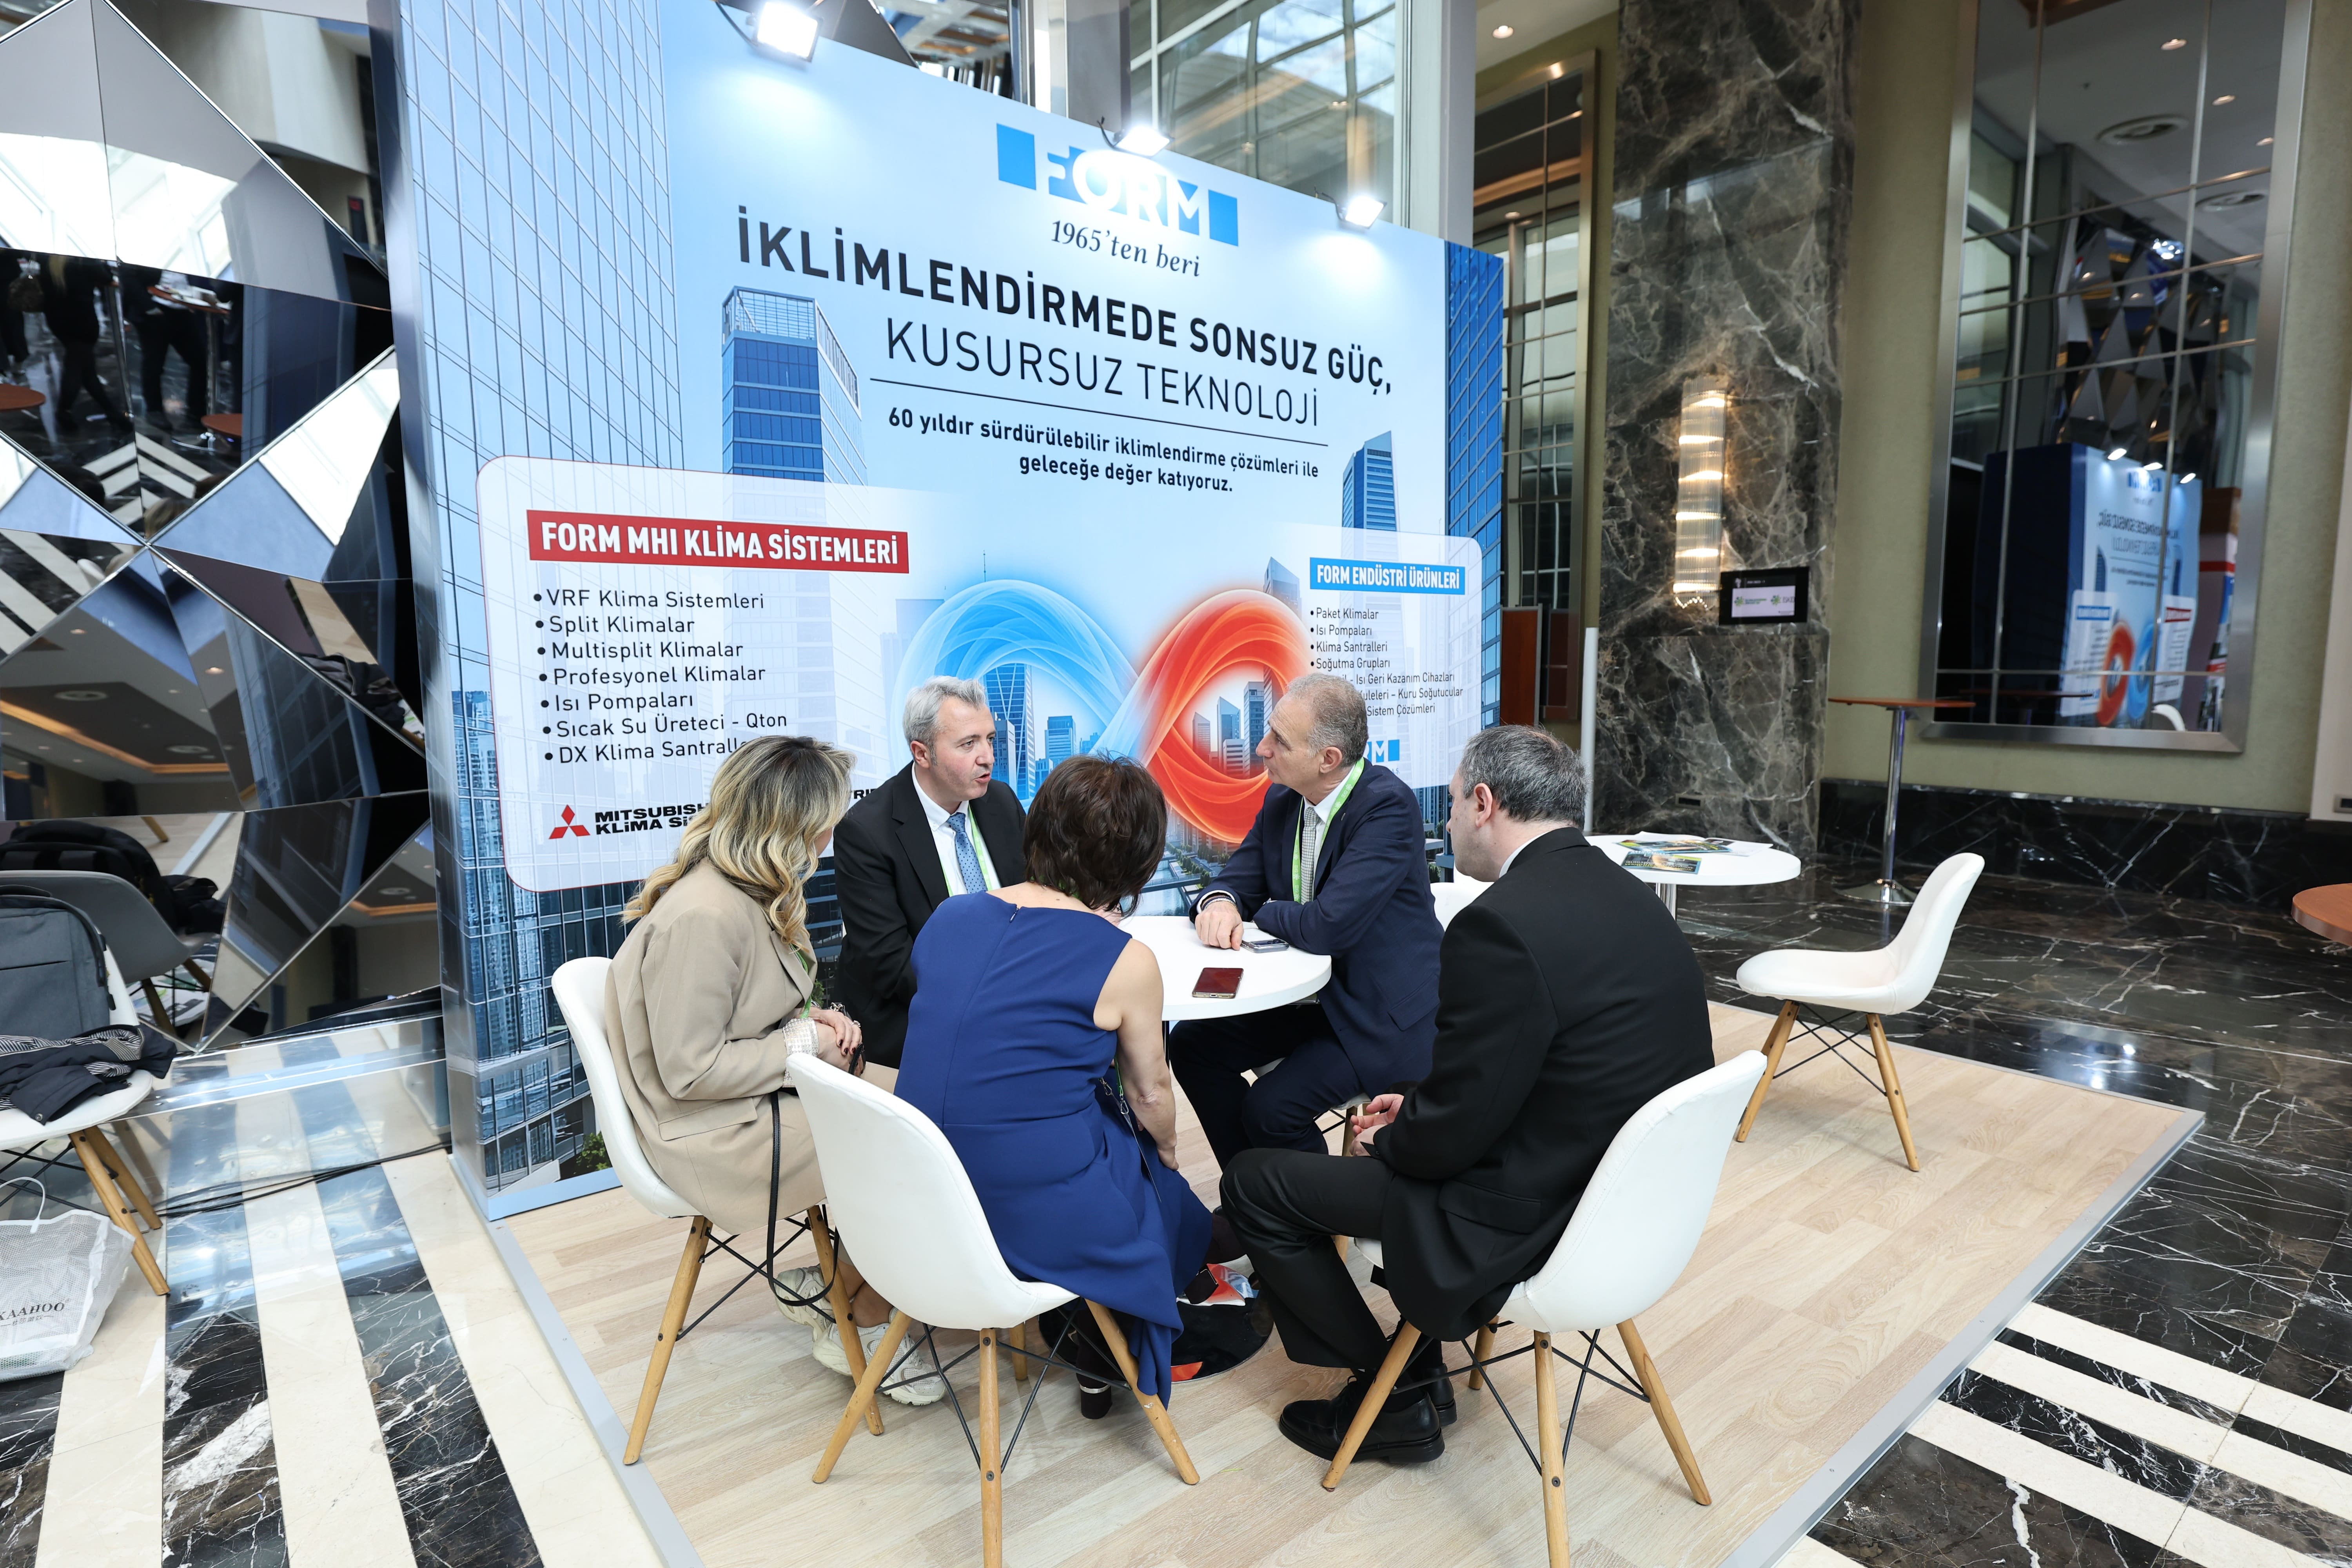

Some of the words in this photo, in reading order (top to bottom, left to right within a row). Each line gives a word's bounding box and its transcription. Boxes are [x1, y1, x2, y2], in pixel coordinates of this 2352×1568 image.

[1039, 142, 1207, 238] FORM
[1052, 221, 1147, 263] 1965’ten
[1156, 245, 1199, 276] beri
[739, 205, 1176, 347] İKLİMLENDİRMEDE
[1190, 318, 1317, 375] SONSUZ
[1328, 343, 1390, 395] GÜÇ,
[888, 318, 1122, 395] KUSURSUZ
[1137, 363, 1316, 426] TEKNOLOJİ
[889, 407, 913, 428] 60
[920, 413, 974, 435] yıldır
[981, 420, 1110, 452] sürdürülebilir
[1116, 437, 1225, 466] iklimlendirme
[1231, 453, 1298, 475] çözümleri
[1303, 461, 1318, 477] ile
[1020, 455, 1099, 480] geleceğe
[1105, 463, 1152, 485] değer
[1158, 468, 1232, 491] katıyoruz.
[542, 522, 620, 552] FORM
[628, 527, 677, 554] MHI
[684, 524, 764, 560] KLİMA
[769, 528, 897, 563] SİSTEMLERİ
[1318, 565, 1349, 584] FORM
[1353, 565, 1406, 586] ENDÜSTRİ
[1410, 567, 1459, 588] ÜRÜNLERİ
[546, 589, 590, 606] VRF
[599, 590, 658, 607] Klima
[666, 592, 763, 608] Sistemleri
[1317, 607, 1340, 619] Paket
[1343, 608, 1379, 619] Klimalar
[550, 615, 599, 637] Split
[608, 616, 695, 632] Klimalar
[1317, 624, 1325, 635] Isı
[1329, 624, 1372, 638] Pompaları
[552, 642, 652, 662] Multisplit
[661, 641, 743, 657] Klimalar
[1317, 641, 1341, 652] Klima
[1344, 641, 1387, 652] Santralleri
[1317, 658, 1354, 671] Soğutma
[1357, 657, 1390, 671] Grupları
[554, 666, 677, 688] Profesyonel
[685, 665, 766, 682] Klimalar
[1357, 674, 1365, 684] Isı
[1368, 673, 1384, 684] Geri
[1388, 673, 1420, 683] Kazanım
[1423, 672, 1454, 682] Cihazları
[556, 695, 579, 711] Isı
[588, 691, 692, 713] Pompaları
[1360, 690, 1388, 700] uleleri
[1399, 688, 1416, 699] Kuru
[1419, 687, 1463, 700] Soğutucular
[1367, 706, 1394, 716] Sistem
[1397, 703, 1435, 717] Çözümleri
[557, 719, 614, 737] Sıcak
[622, 718, 646, 734] Su
[655, 713, 724, 732] Üreteci
[747, 713, 786, 728] Qton
[559, 746, 587, 763] DX
[596, 744, 654, 761] Klima
[662, 737, 747, 757] Santrall
[595, 803, 709, 823] MITSUBIS
[596, 819, 663, 835] KLiMA
